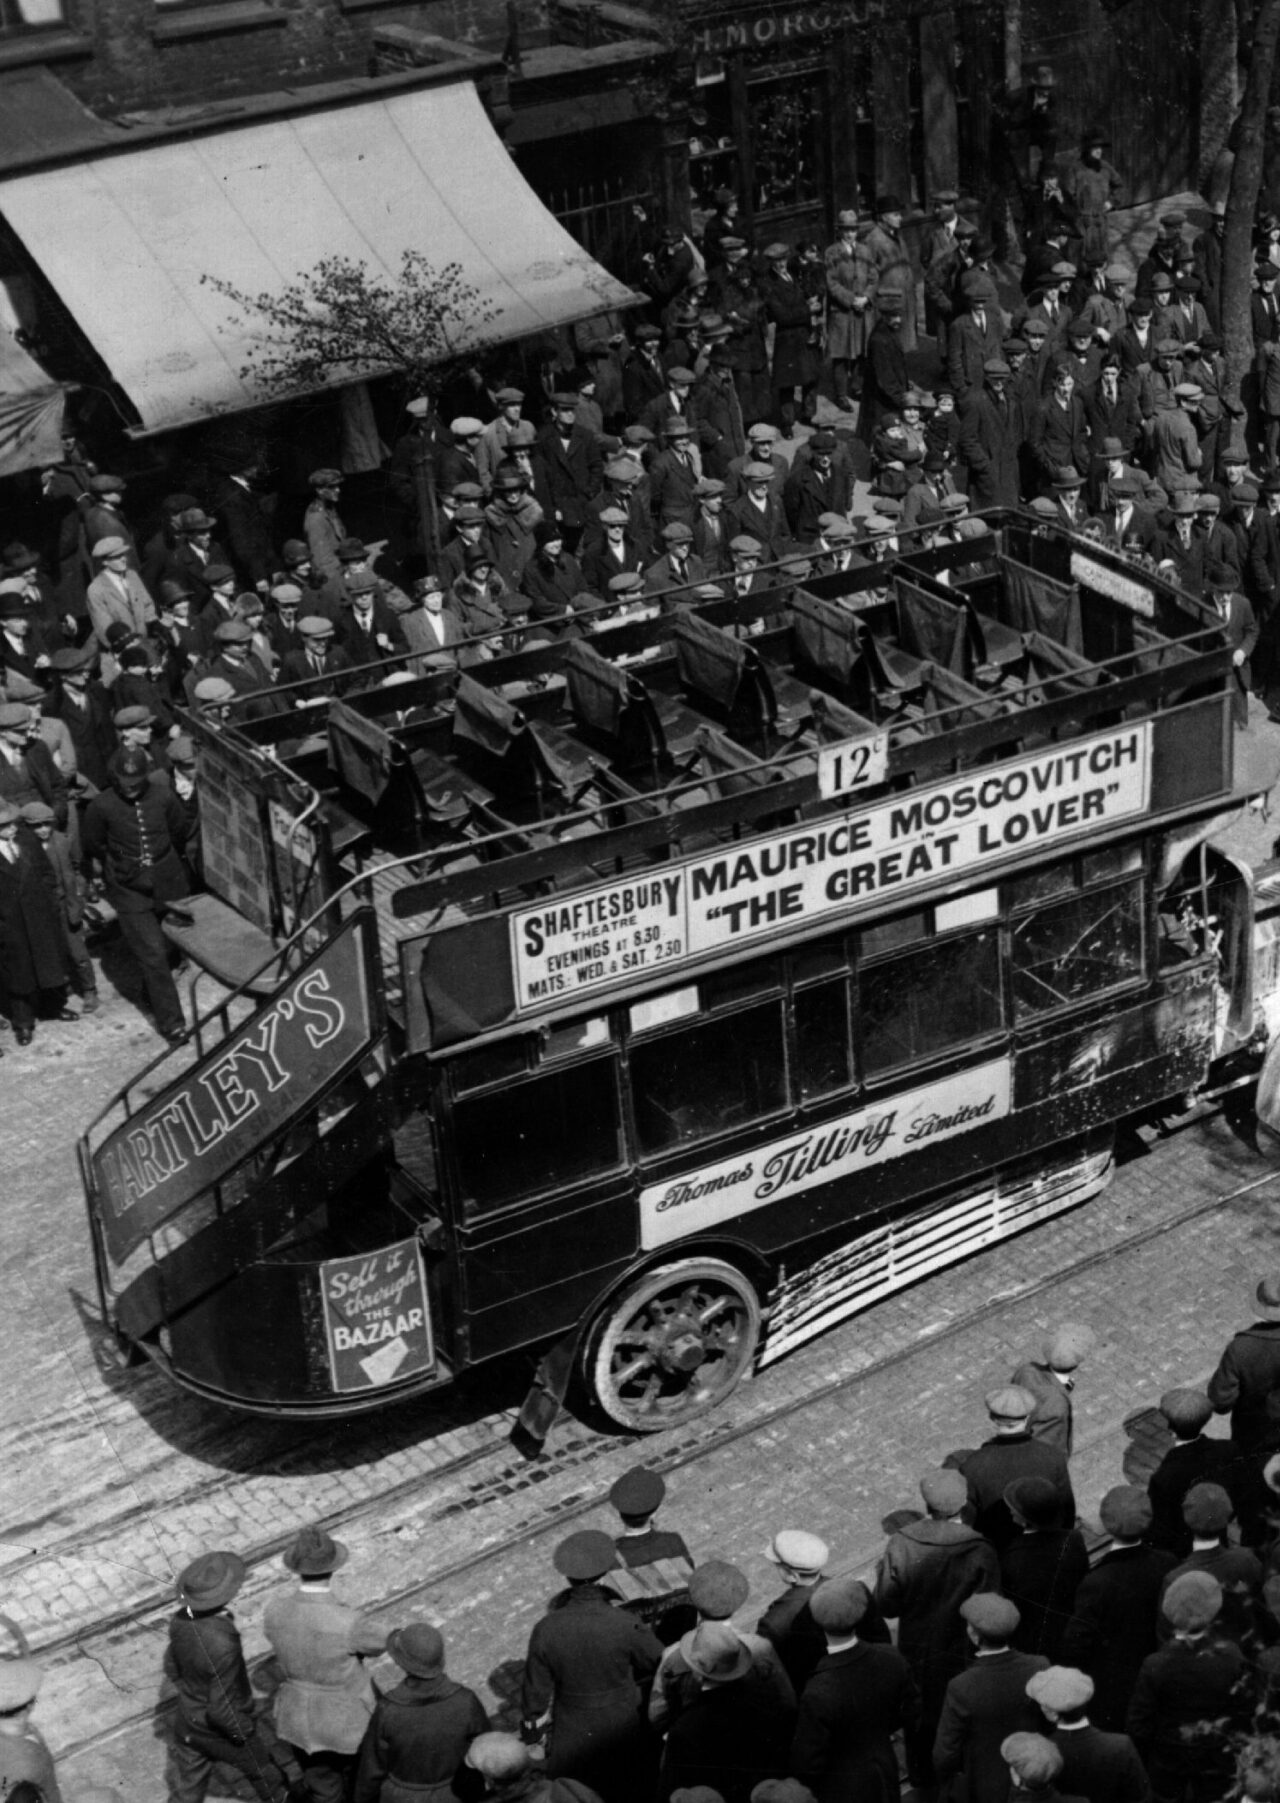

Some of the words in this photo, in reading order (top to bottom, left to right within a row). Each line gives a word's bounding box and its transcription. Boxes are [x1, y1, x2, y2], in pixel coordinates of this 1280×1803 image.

[691, 818, 872, 901] MAURICE
[890, 734, 1138, 840] MOSCOVITCH
[825, 833, 960, 901] GREAT
[524, 875, 682, 957] SHAFTESBURY
[572, 915, 638, 942] THEATRE
[547, 940, 610, 973] EVENINGS
[616, 938, 628, 952] AT
[101, 968, 345, 1218] HARTLEY'S
[655, 1162, 754, 1213] Thomas
[754, 1110, 898, 1200] Tilling
[903, 1094, 995, 1144] Limited
[328, 1257, 378, 1300] Sell
[386, 1250, 404, 1273] it
[344, 1258, 418, 1317] through
[333, 1308, 423, 1351] BAZAAR
[363, 1306, 393, 1321] THE
